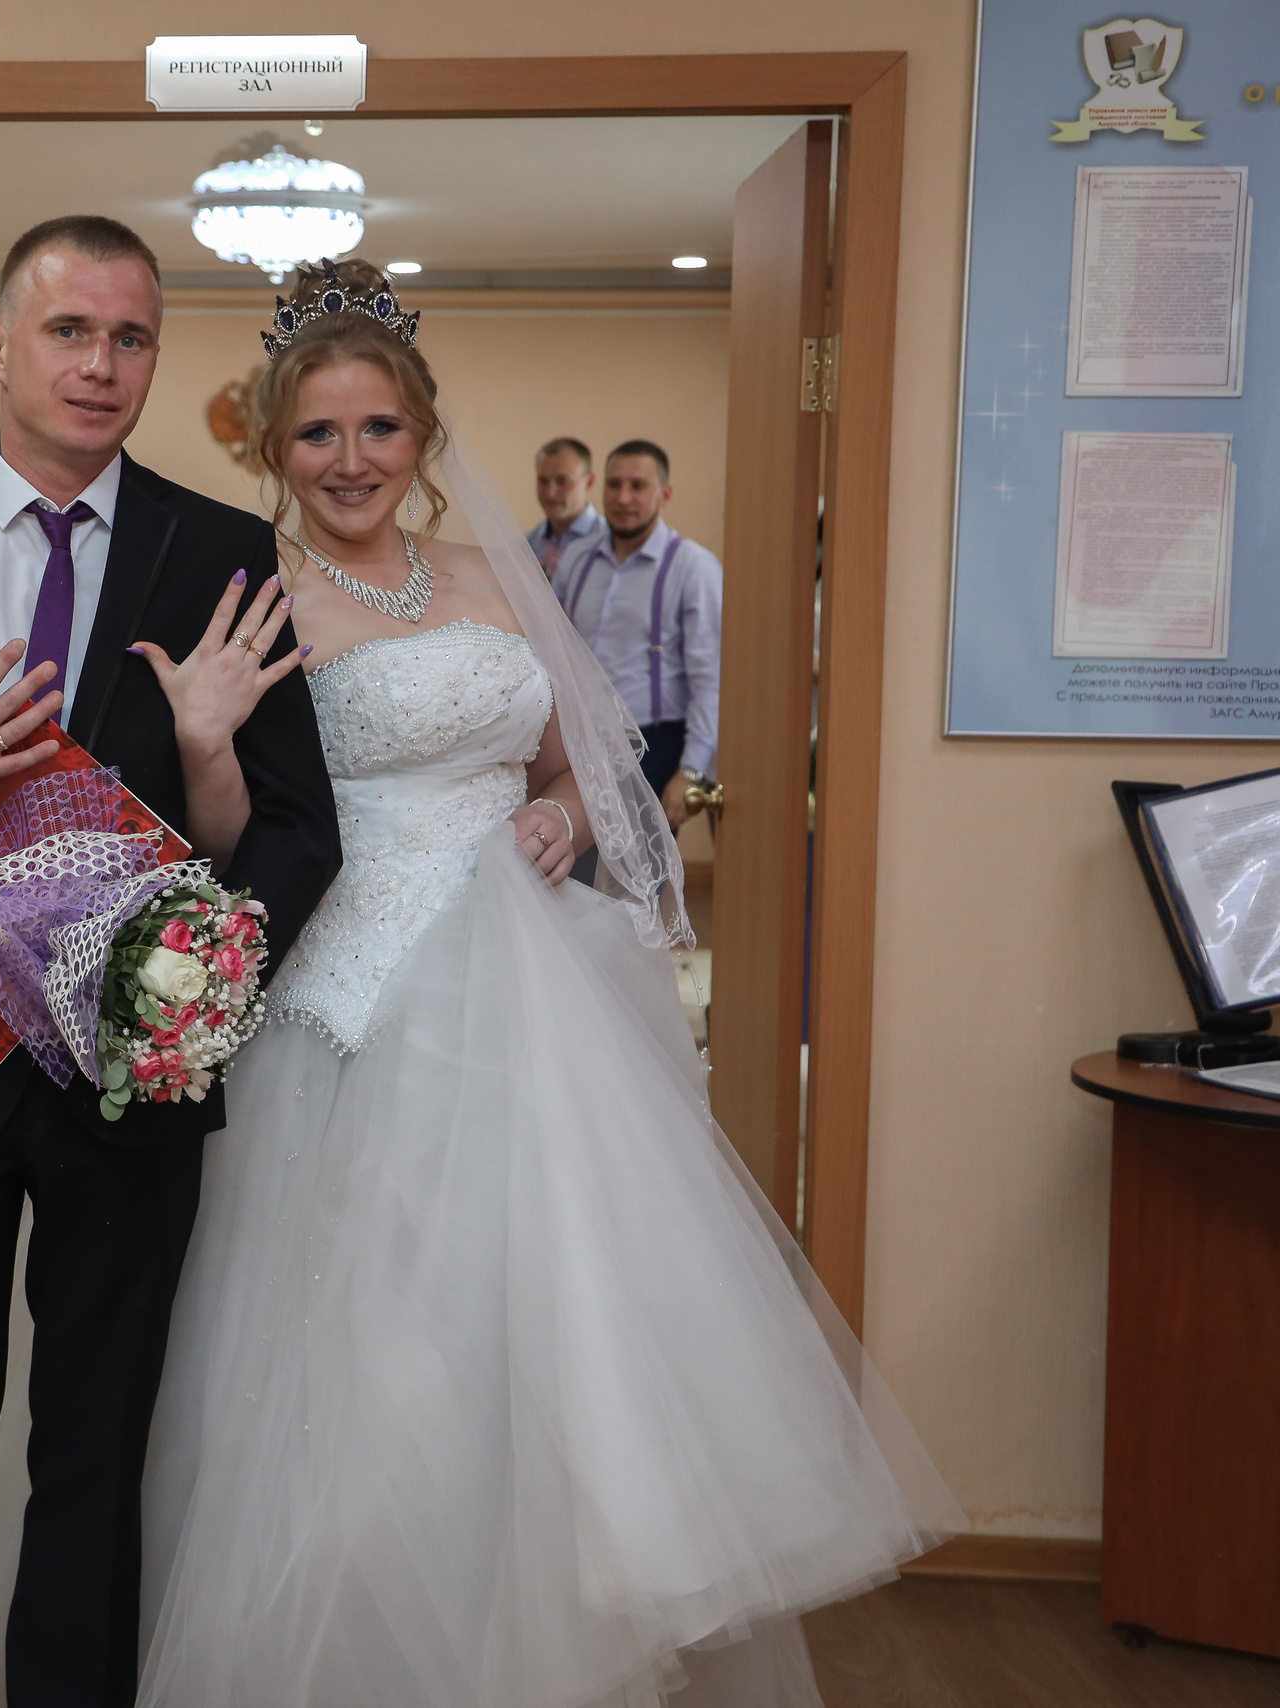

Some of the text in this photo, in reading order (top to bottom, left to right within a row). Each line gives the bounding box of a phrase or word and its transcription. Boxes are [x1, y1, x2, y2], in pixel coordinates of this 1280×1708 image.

[169, 55, 344, 77] РЕГИСТРАЦИОННЫЙ
[237, 78, 273, 92] ЗАЛ
[1246, 85, 1264, 102] о
[1072, 663, 1187, 677] Дополнительную
[1067, 679, 1121, 688] можете
[1124, 680, 1183, 691] получить
[1185, 680, 1203, 688] на
[1207, 678, 1248, 689] сайте
[1056, 690, 1067, 701] С
[1070, 693, 1183, 705] предложениями
[1185, 695, 1195, 703] и
[1210, 707, 1244, 718] ЗАГС
